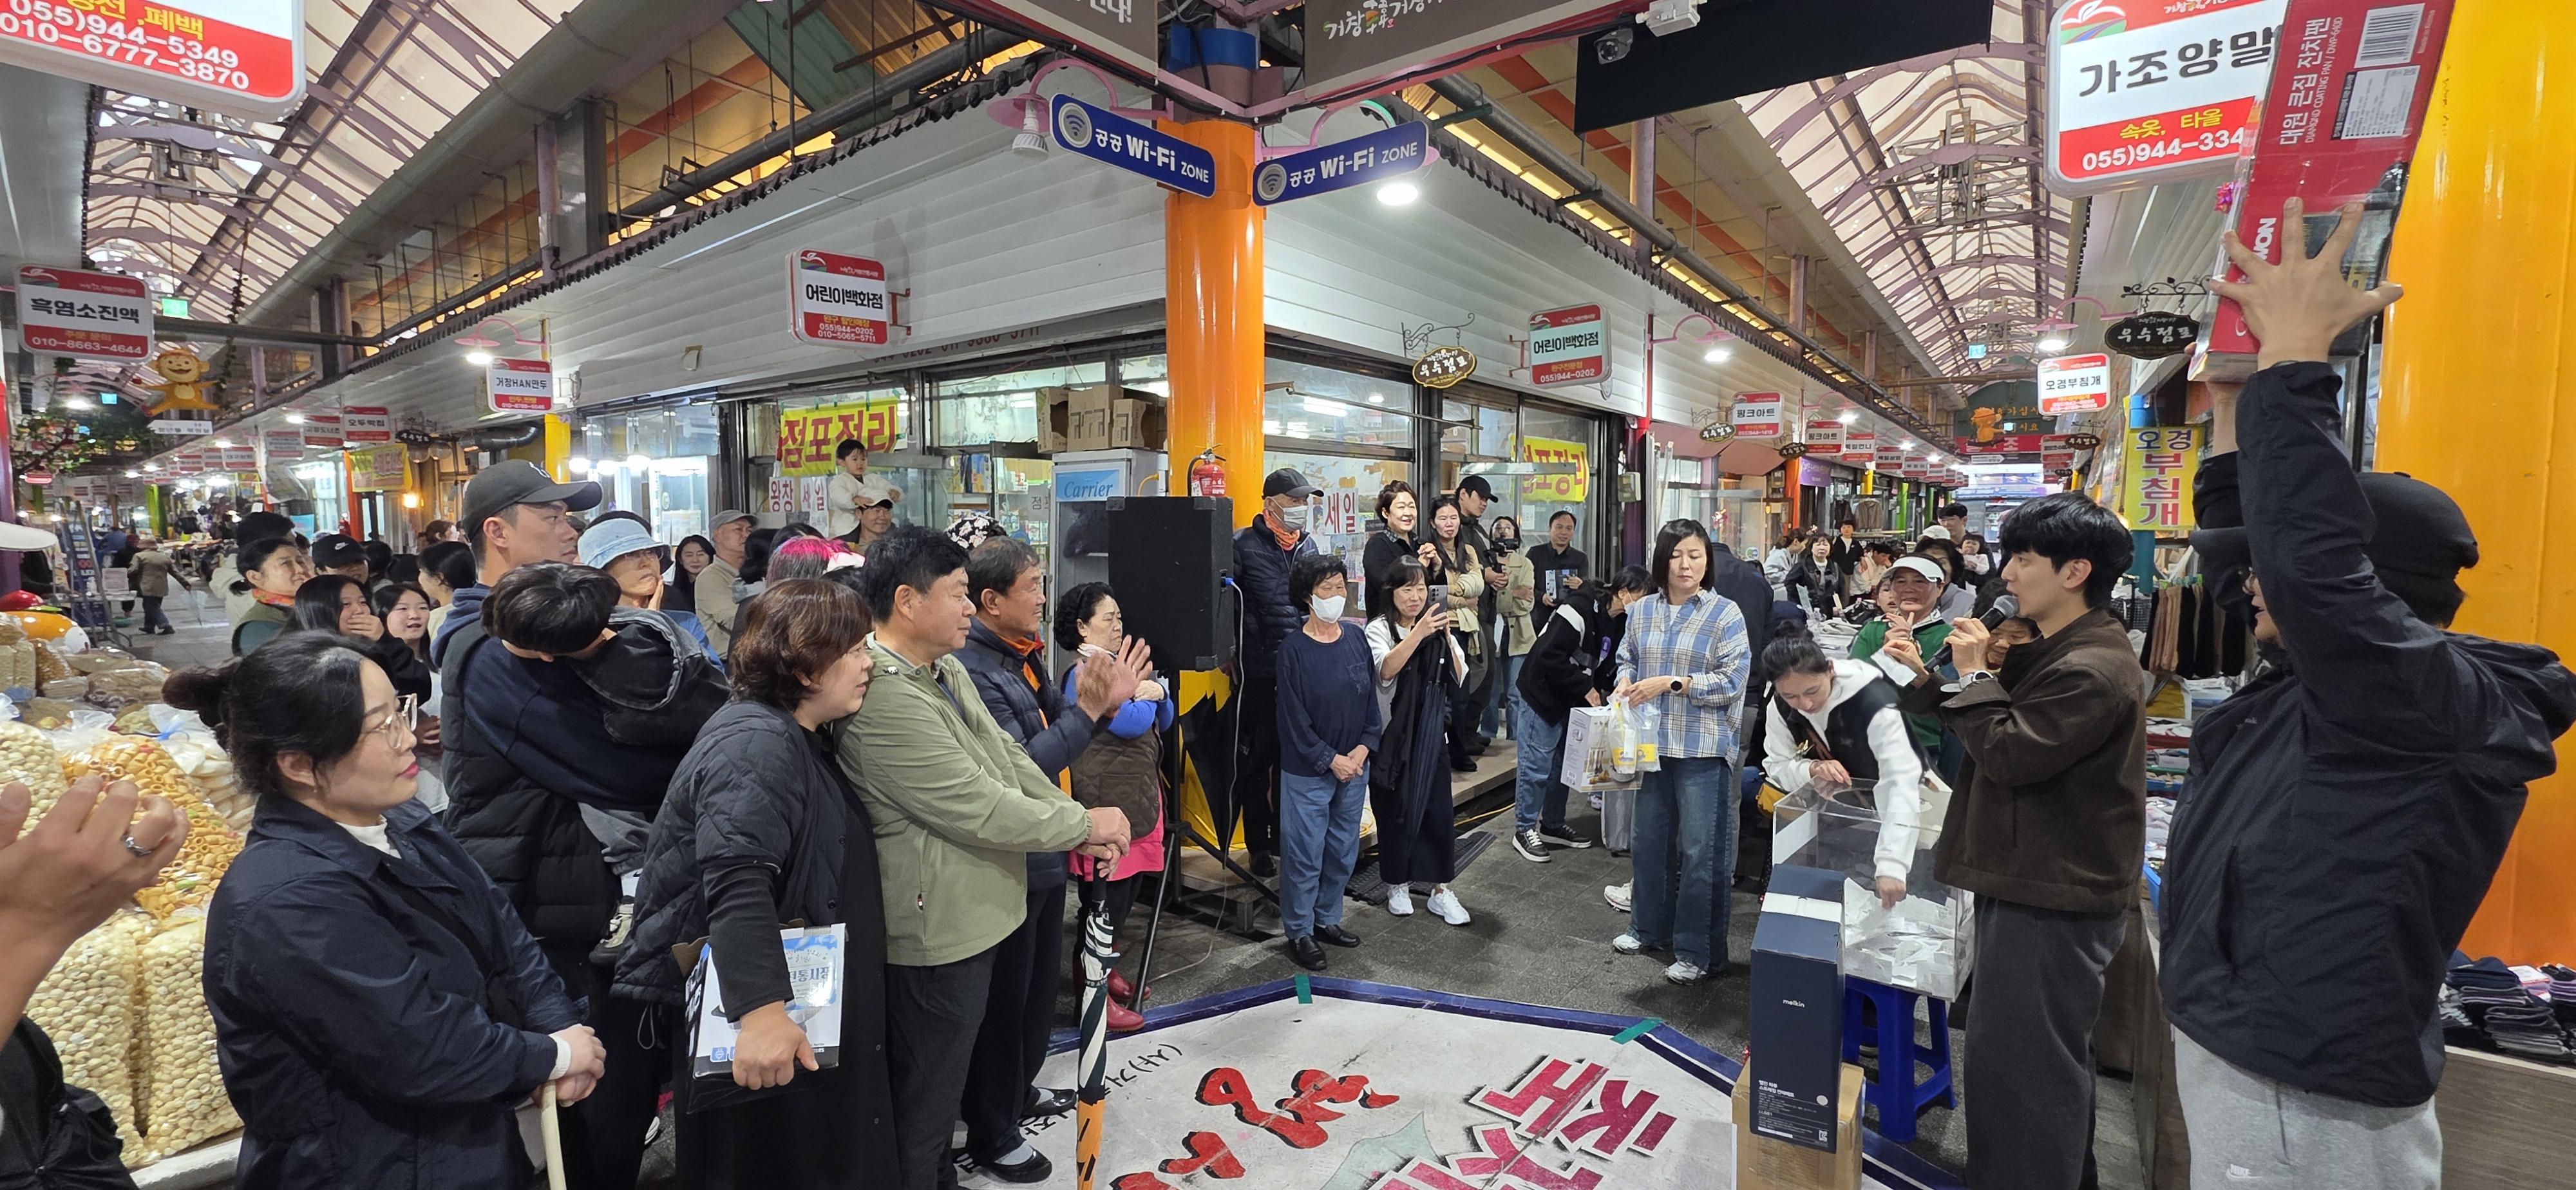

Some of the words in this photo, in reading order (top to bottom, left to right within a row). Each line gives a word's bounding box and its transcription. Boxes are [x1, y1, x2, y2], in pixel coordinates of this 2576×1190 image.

[10, 0, 239, 68] 055)944-5349
[2297, 17, 2331, 68] 잔치팬
[0, 13, 249, 90] 010-6777-3870
[2079, 25, 2282, 97] 가조양말
[2288, 74, 2318, 107] 큰집
[2304, 110, 2321, 144] DIAMOND
[2313, 77, 2329, 109] COATING
[2322, 61, 2332, 75] PAN
[2181, 108, 2222, 129] 타올
[2280, 111, 2308, 145] 대원
[1095, 129, 1122, 153] 공공
[1126, 134, 1175, 171] Wi-Fi
[1181, 162, 1209, 184] ZONE
[1290, 168, 1316, 187] 공공
[1320, 147, 1374, 179] Wi-Fi
[1381, 142, 1417, 164] ZONE
[806, 284, 883, 310] 어린이백화점
[31, 298, 140, 323] 흑염소진액
[818, 330, 876, 342] 010-5065-5711
[819, 323, 874, 335] 055)944-0202
[2117, 326, 2193, 344] 우수점포
[32, 337, 142, 354] 010-8663-4644
[1533, 332, 1598, 354] 어린이백화점
[1420, 356, 1468, 376] 우수점포
[1540, 368, 1595, 382] 055)944-0202
[496, 377, 547, 390] 거창HAN만두
[2046, 375, 2101, 390] 오경부침개
[1737, 408, 1775, 418] 핑크아트
[782, 406, 895, 469] 점포정리
[2136, 430, 2192, 450] 오경
[770, 480, 794, 512] 왕창
[1064, 480, 1114, 498] Carrier
[2139, 453, 2183, 525] 부침개
[1325, 492, 1356, 534] 세일
